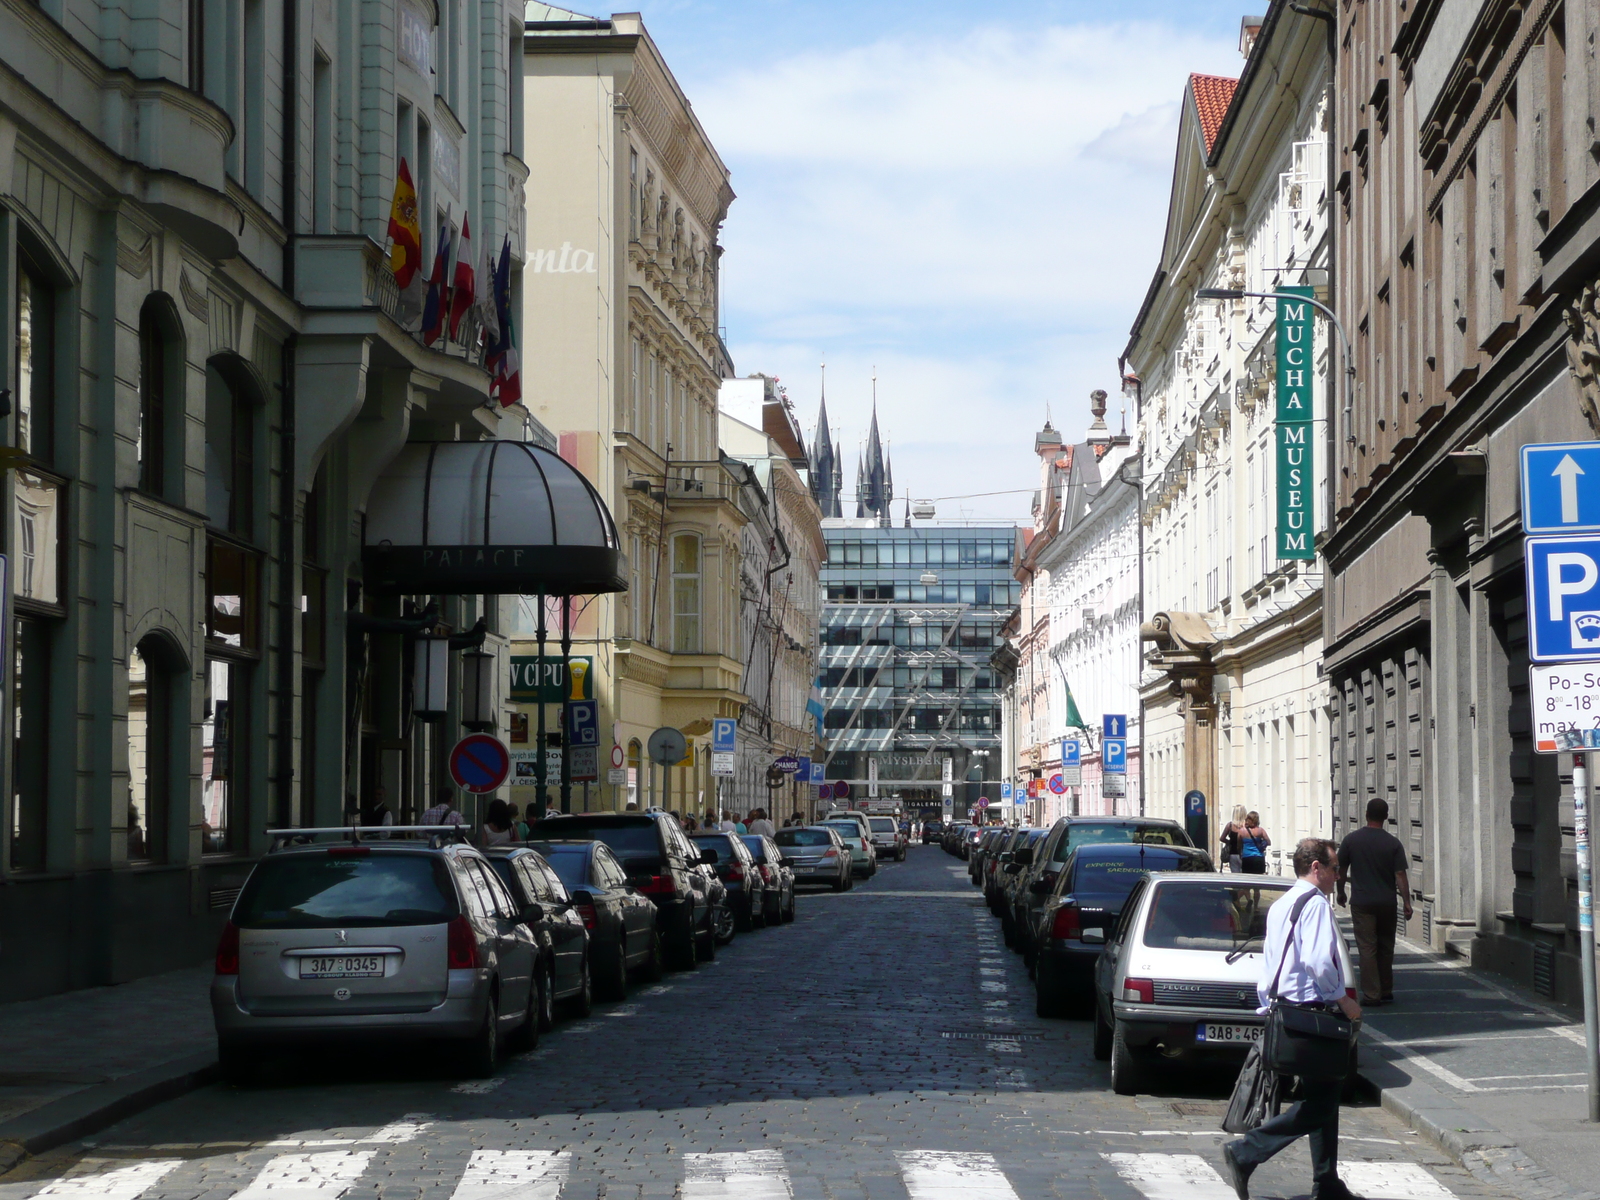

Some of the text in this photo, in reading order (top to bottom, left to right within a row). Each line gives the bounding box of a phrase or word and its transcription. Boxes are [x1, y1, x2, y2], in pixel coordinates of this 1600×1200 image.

[1284, 303, 1306, 551] MUCHA MUSEUM
[1547, 552, 1598, 621] P
[524, 657, 564, 687] CÍPU
[572, 705, 591, 733] P
[718, 723, 731, 741] P
[1065, 743, 1076, 758] P
[1107, 743, 1121, 762] P
[814, 765, 822, 777] P
[1003, 785, 1010, 794] P
[1017, 791, 1024, 800] P
[1191, 797, 1200, 810] P
[311, 958, 378, 972] 3A7 0345
[1208, 1026, 1233, 1040] 3A8
